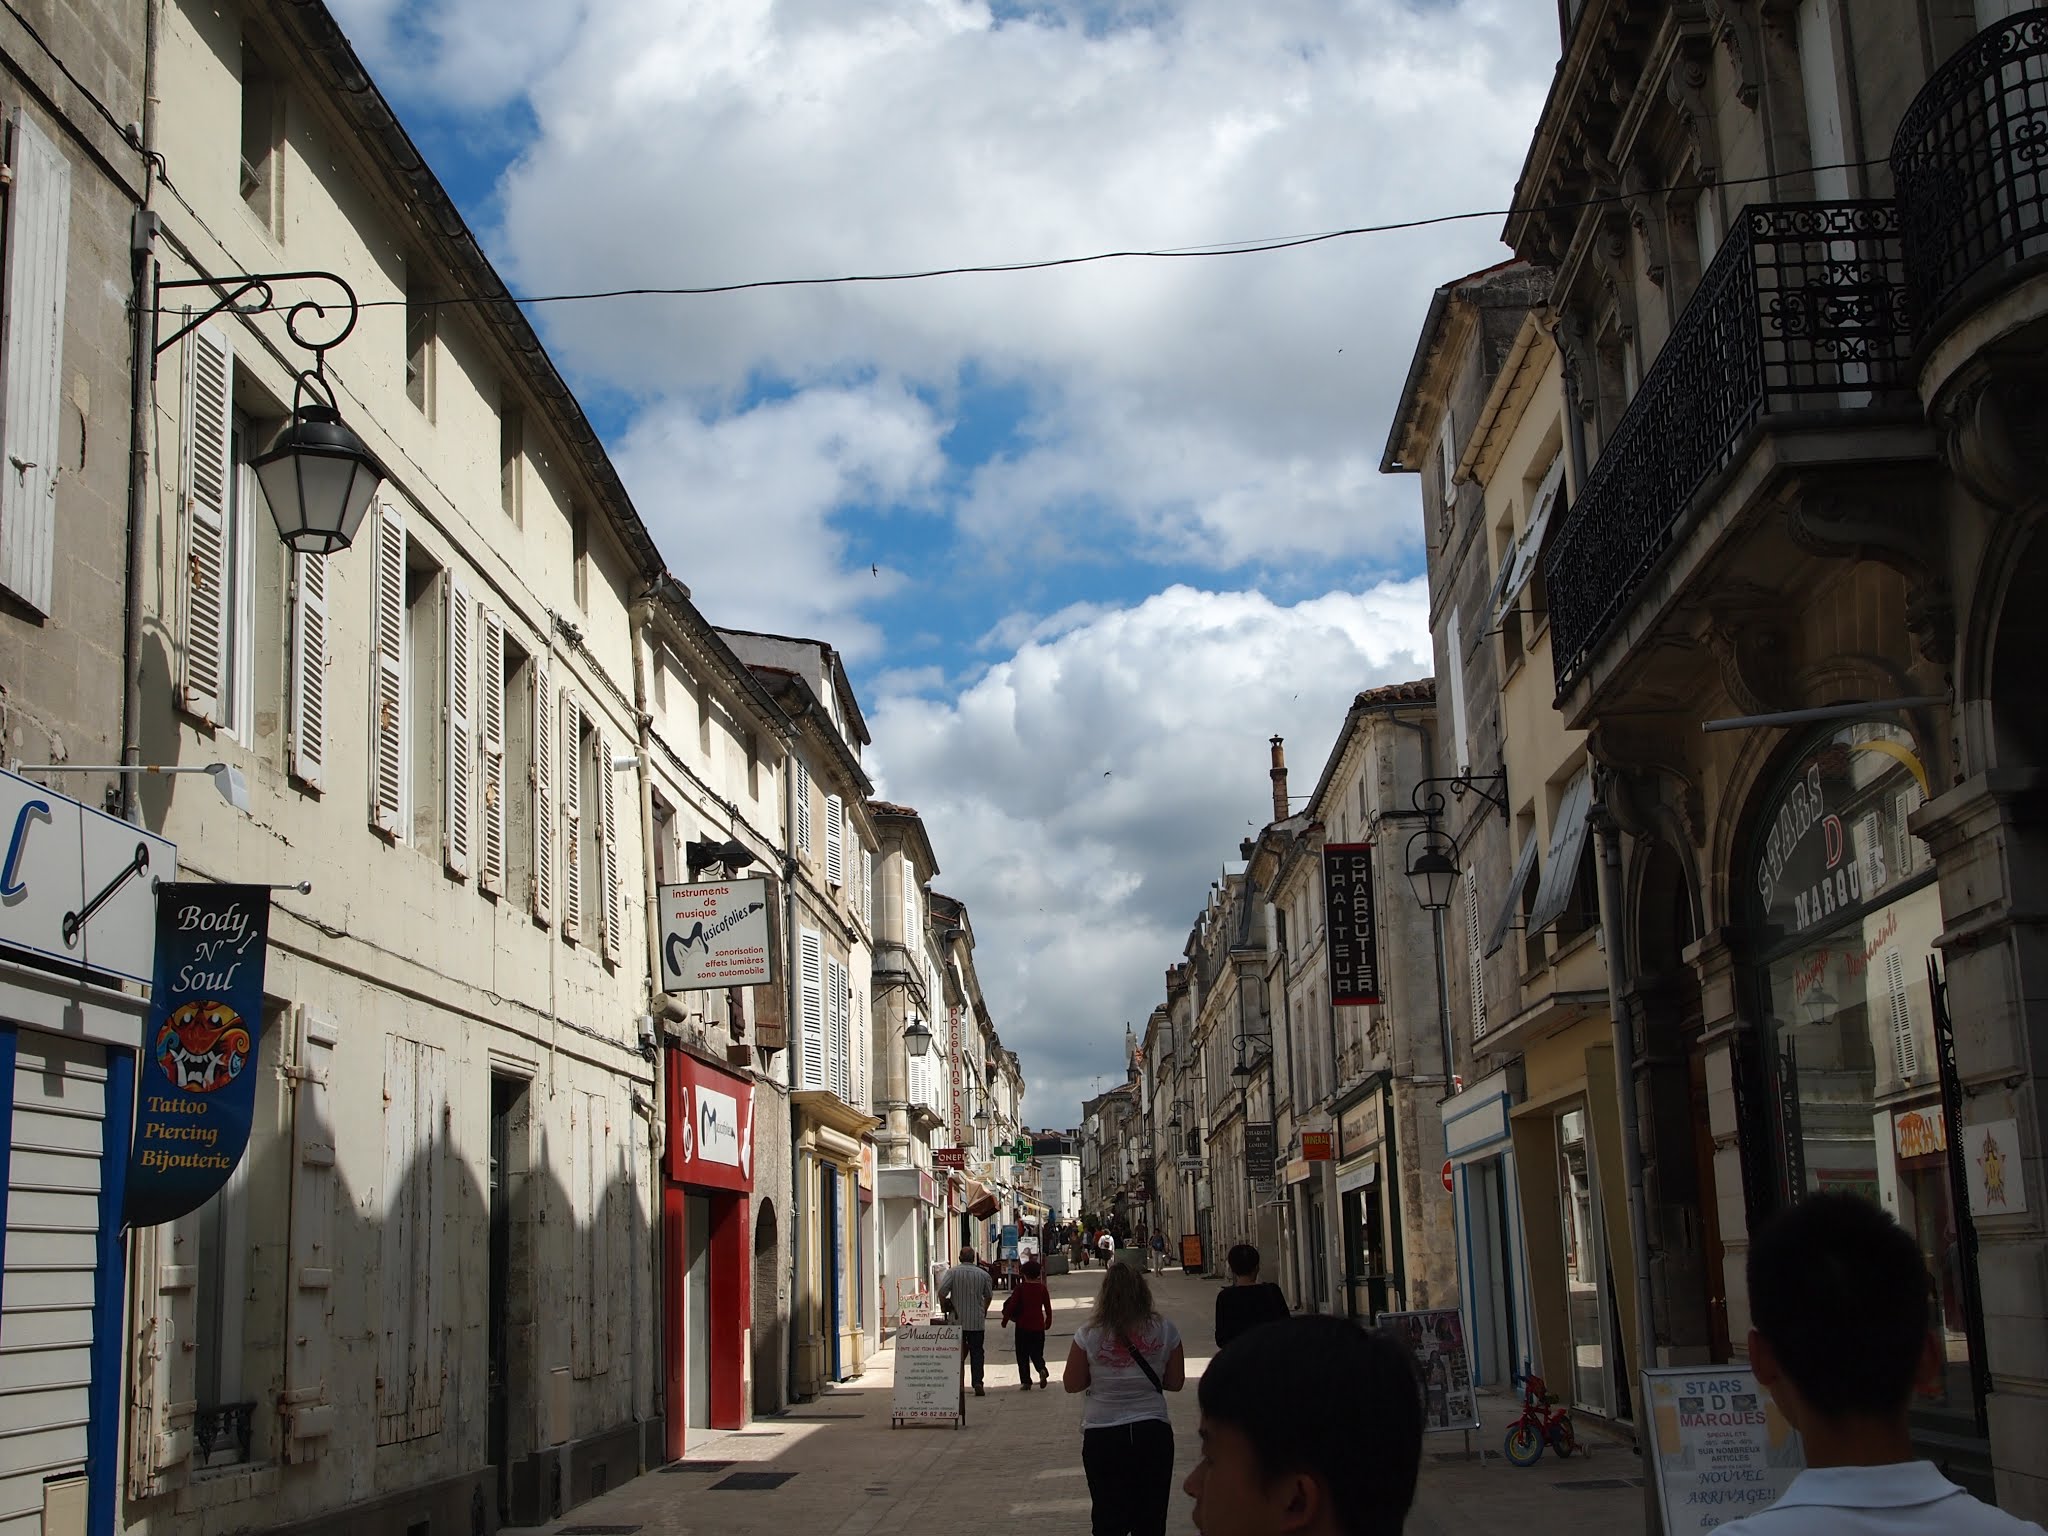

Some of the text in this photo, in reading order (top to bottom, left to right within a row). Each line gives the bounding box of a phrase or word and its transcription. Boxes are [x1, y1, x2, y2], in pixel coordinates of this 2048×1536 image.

[1758, 763, 1823, 915] STARS
[1822, 814, 1843, 869] D
[672, 886, 729, 898] instruments
[1795, 844, 1887, 931] MARQUES
[703, 898, 717, 906] de
[675, 909, 717, 919] musique
[178, 903, 249, 943] Body
[1331, 857, 1351, 992] TRAITEUR
[1351, 857, 1373, 992] CHARCUTIER
[666, 907, 748, 977] Musicofolies
[715, 946, 764, 956] sonorisation
[705, 956, 764, 968] effets lumières
[172, 962, 242, 993] Soul
[697, 967, 765, 979] sono automobile
[148, 1096, 208, 1114] Tattoo
[144, 1122, 218, 1147] Piercing
[1304, 1135, 1329, 1145] MINERAL
[140, 1149, 230, 1174] Bijouterie
[1180, 1160, 1203, 1168] pressing
[899, 1327, 960, 1345] Musicofolies
[1685, 1379, 1743, 1395] STARS
[1712, 1395, 1726, 1411] D
[1680, 1411, 1767, 1428] MARQUES
[1712, 1454, 1751, 1462] ARTICLES
[1716, 1446, 1761, 1454] NOMBREUX
[1698, 1470, 1765, 1485] NOUVEL
[1686, 1488, 1777, 1505] ARRIVAGE!!
[1700, 1513, 1720, 1527] des
